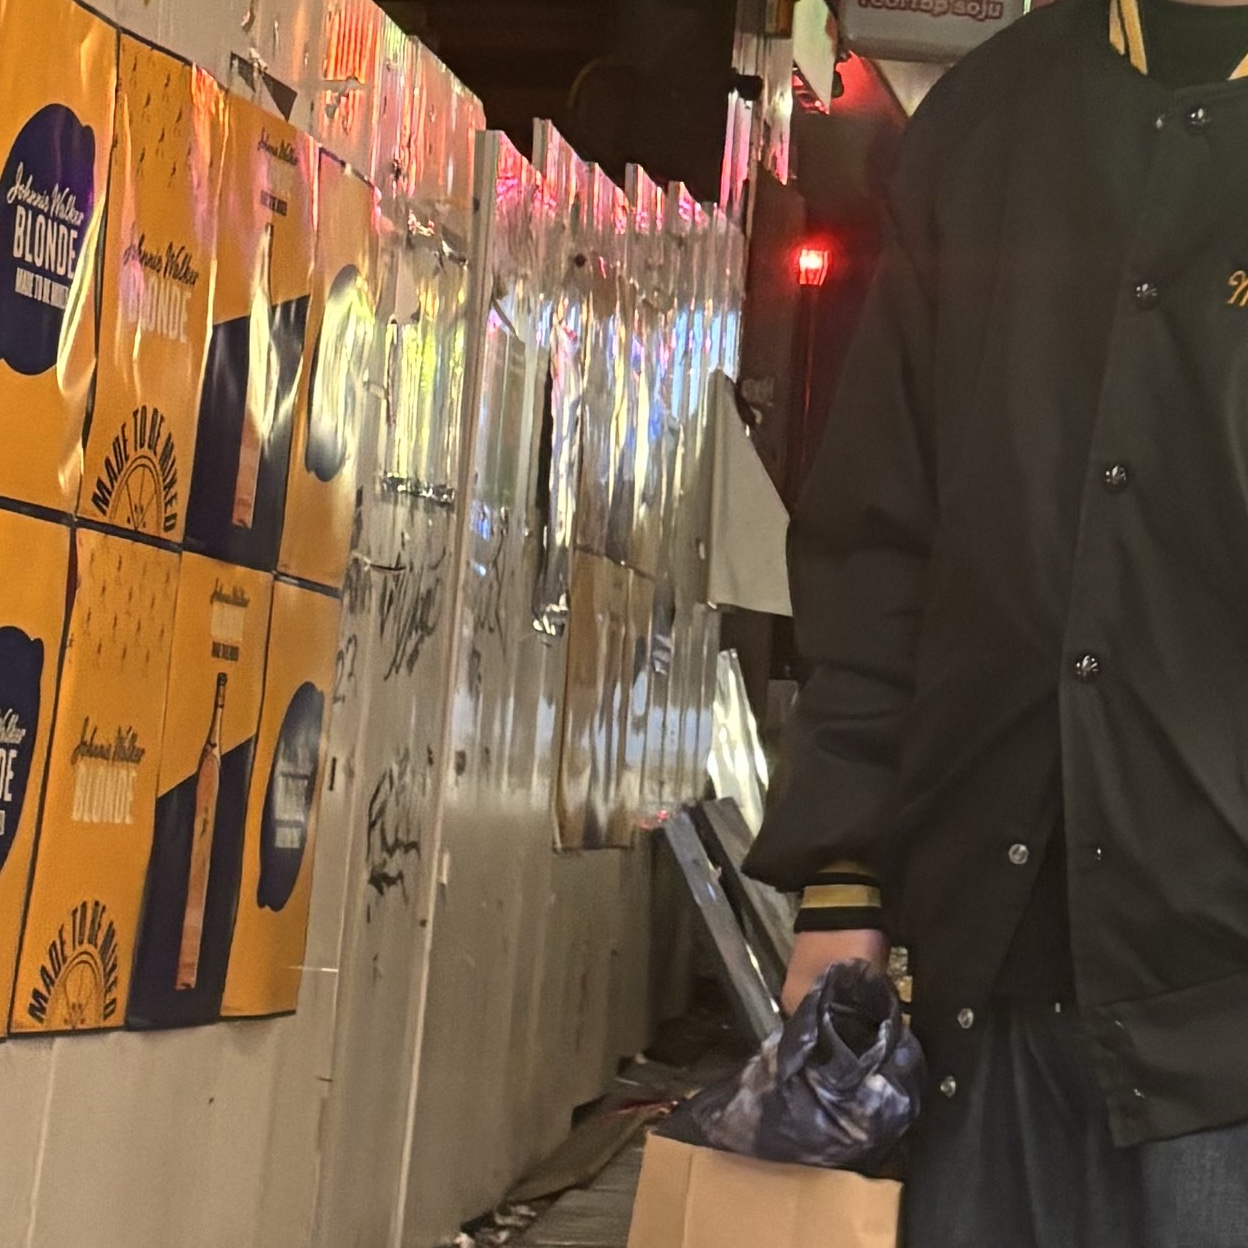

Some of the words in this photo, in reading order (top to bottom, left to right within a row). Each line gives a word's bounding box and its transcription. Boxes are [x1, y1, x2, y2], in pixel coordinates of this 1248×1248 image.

[13, 204, 78, 280] BLONDE
[91, 422, 129, 516] MADE
[133, 405, 147, 452] TO
[148, 407, 165, 457] BE
[28, 923, 67, 1024] MADE
[72, 900, 86, 951] TO
